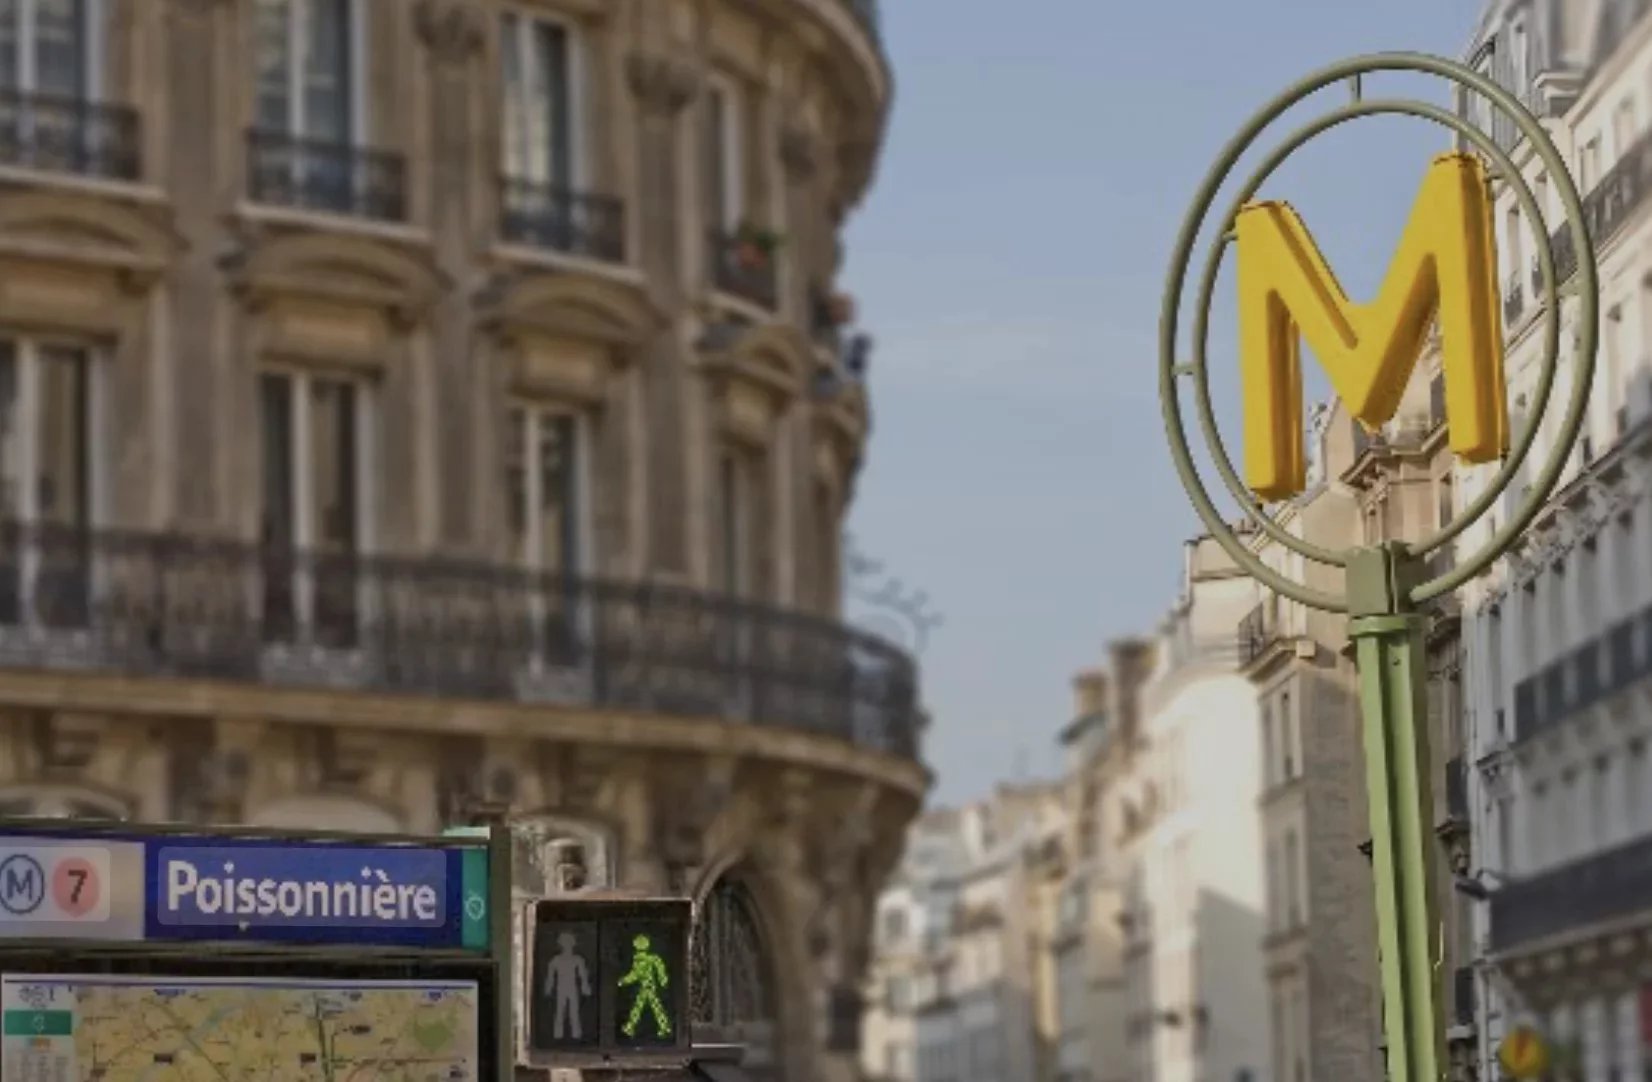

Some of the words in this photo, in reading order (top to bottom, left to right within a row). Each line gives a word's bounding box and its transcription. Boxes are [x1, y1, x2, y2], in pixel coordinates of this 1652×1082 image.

[1235, 150, 1510, 502] M
[7, 869, 34, 900] M
[67, 869, 88, 904] 7
[167, 859, 437, 920] Poissonnière
